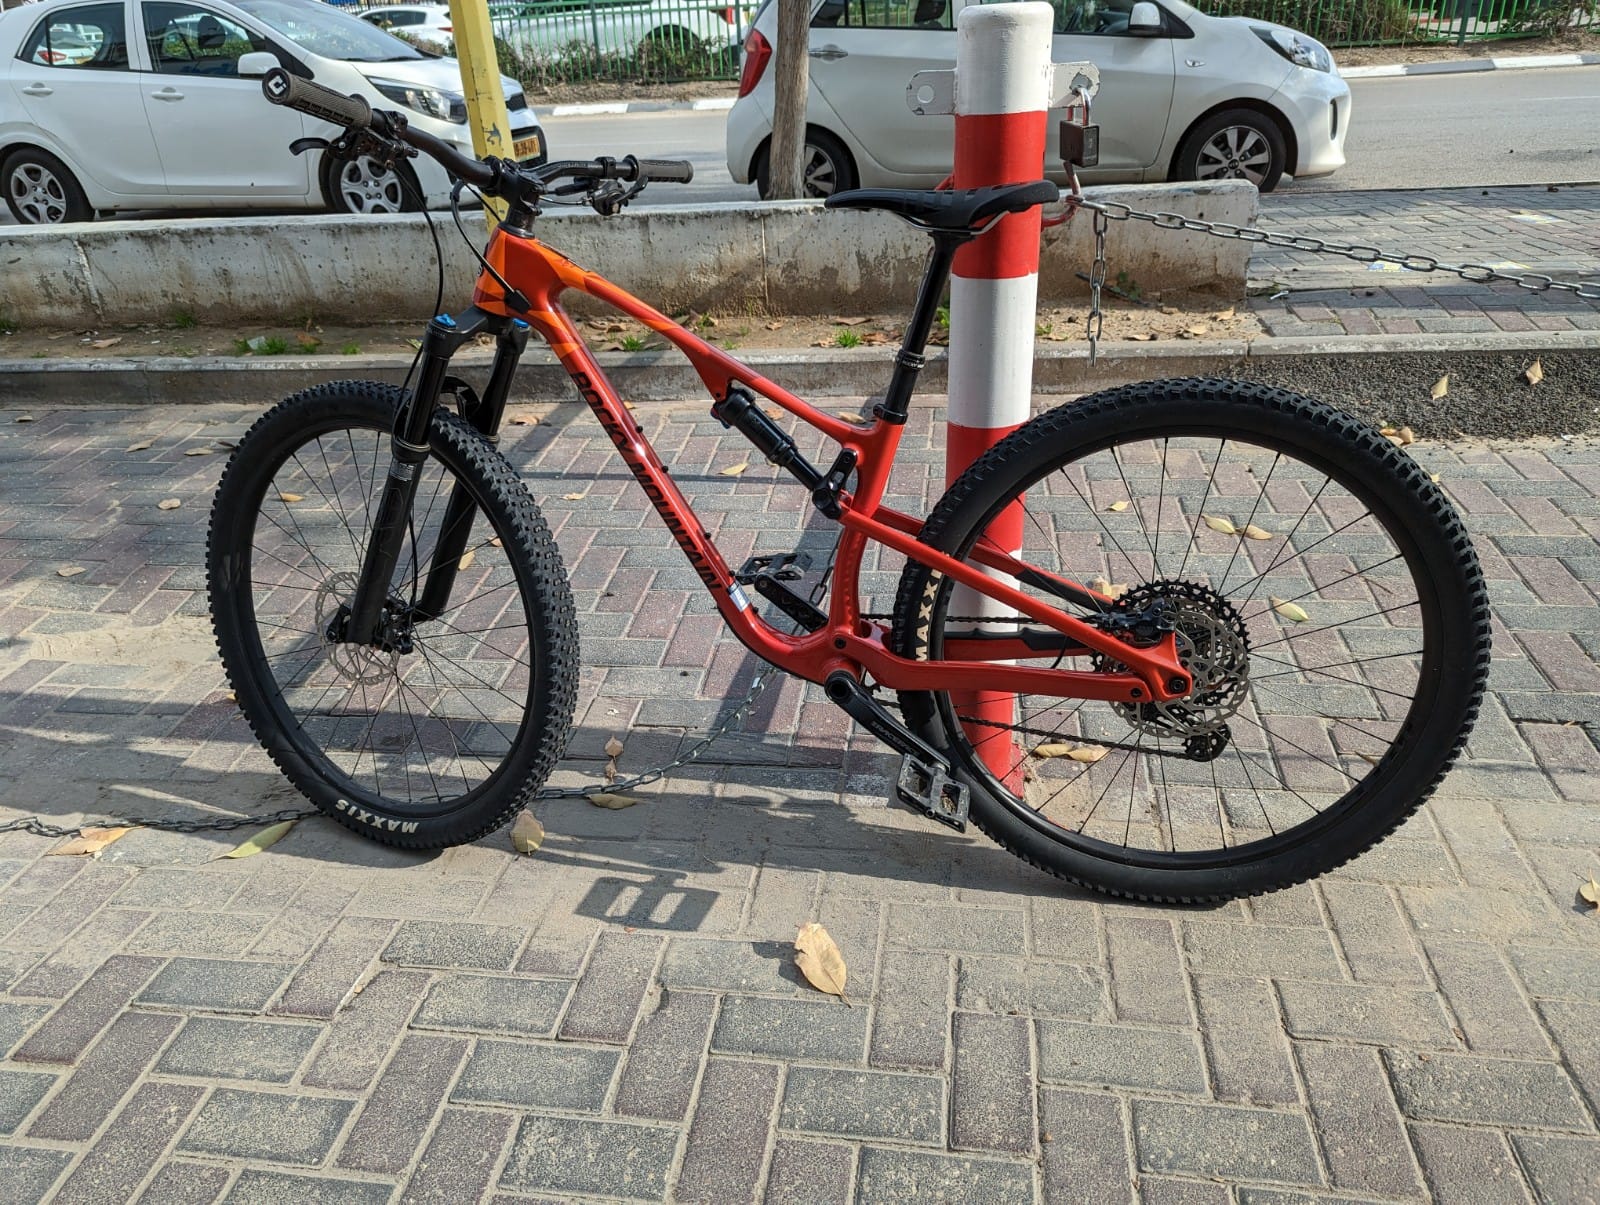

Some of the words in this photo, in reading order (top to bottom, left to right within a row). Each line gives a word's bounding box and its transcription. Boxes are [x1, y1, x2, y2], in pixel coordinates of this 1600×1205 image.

[569, 372, 636, 459] ROCKY
[628, 461, 722, 589] MOUNTAIN
[915, 567, 943, 661] MAXXI
[335, 799, 420, 834] MAXXIS
